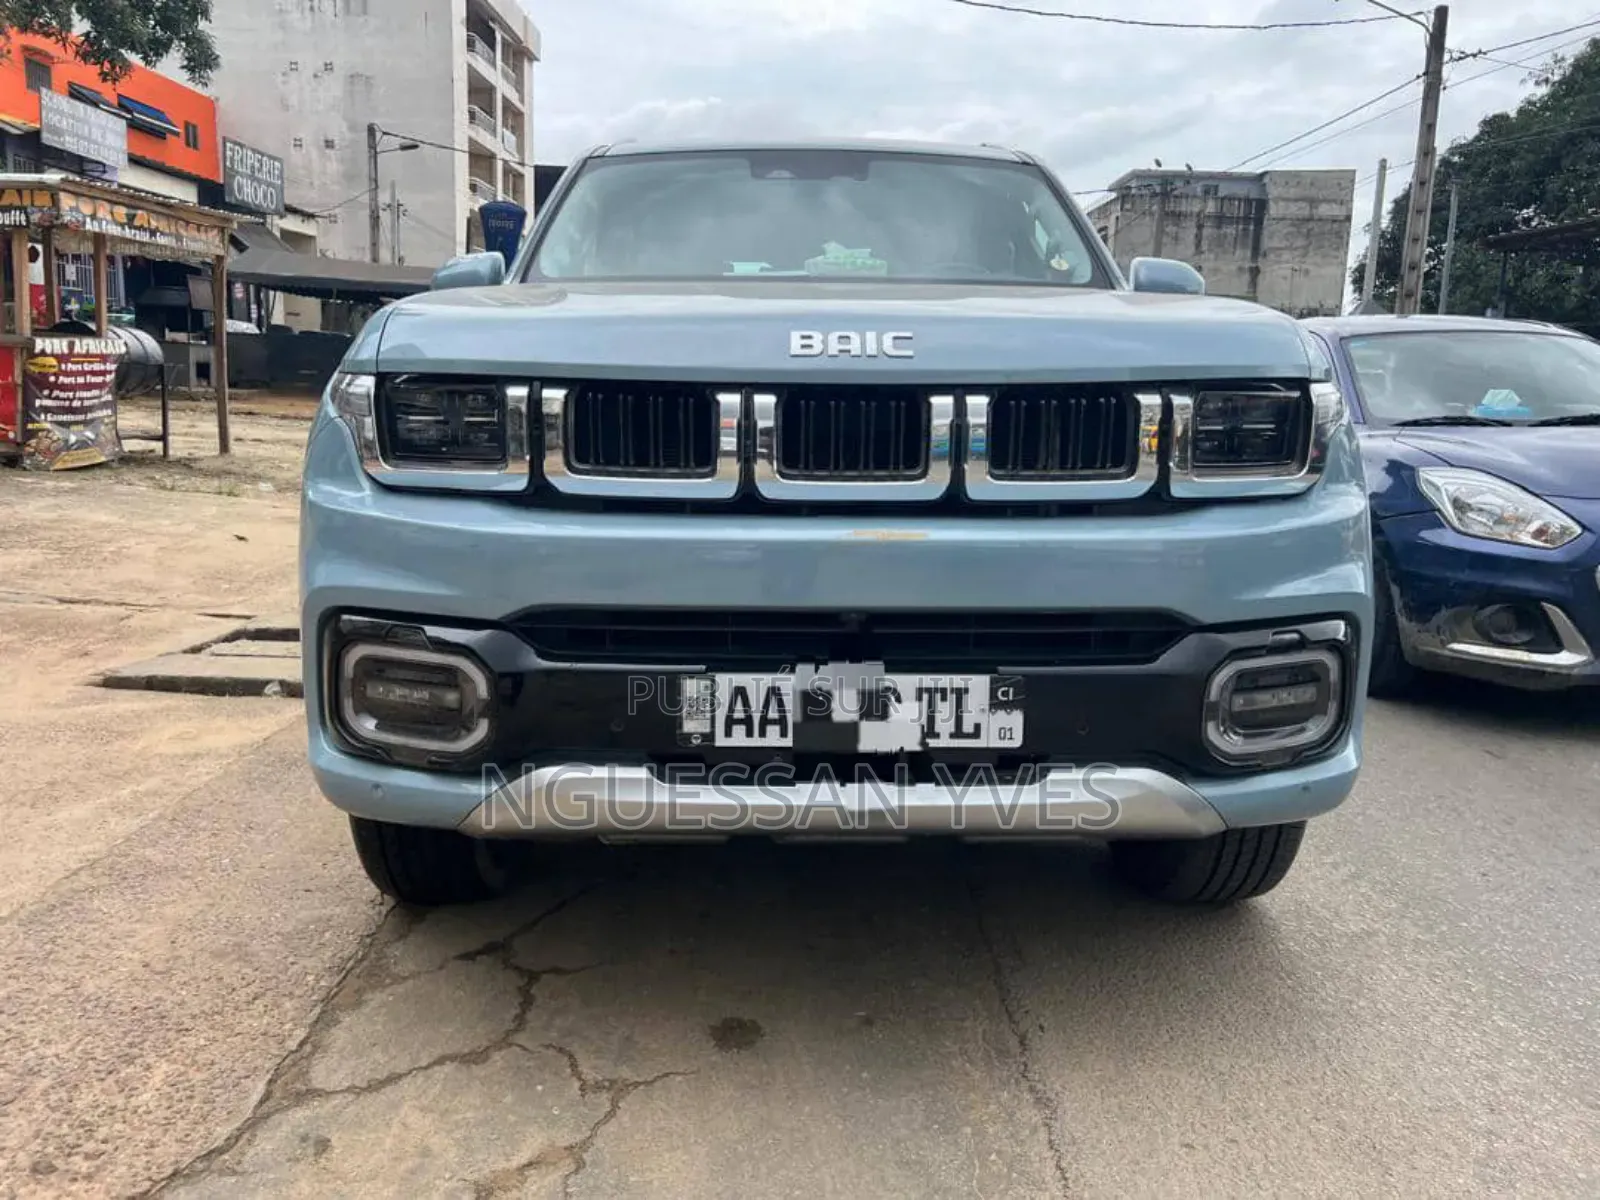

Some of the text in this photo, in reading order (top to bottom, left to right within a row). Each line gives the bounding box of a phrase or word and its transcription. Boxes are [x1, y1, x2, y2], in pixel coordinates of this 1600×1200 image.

[226, 142, 281, 185] FRIPERIE
[234, 175, 277, 209] CHOCO
[34, 337, 69, 355] PORC
[790, 331, 915, 358] BAIC
[997, 687, 1014, 701] CI
[724, 685, 789, 739] AA
[915, 686, 982, 740] TL
[998, 727, 1015, 741] 01
